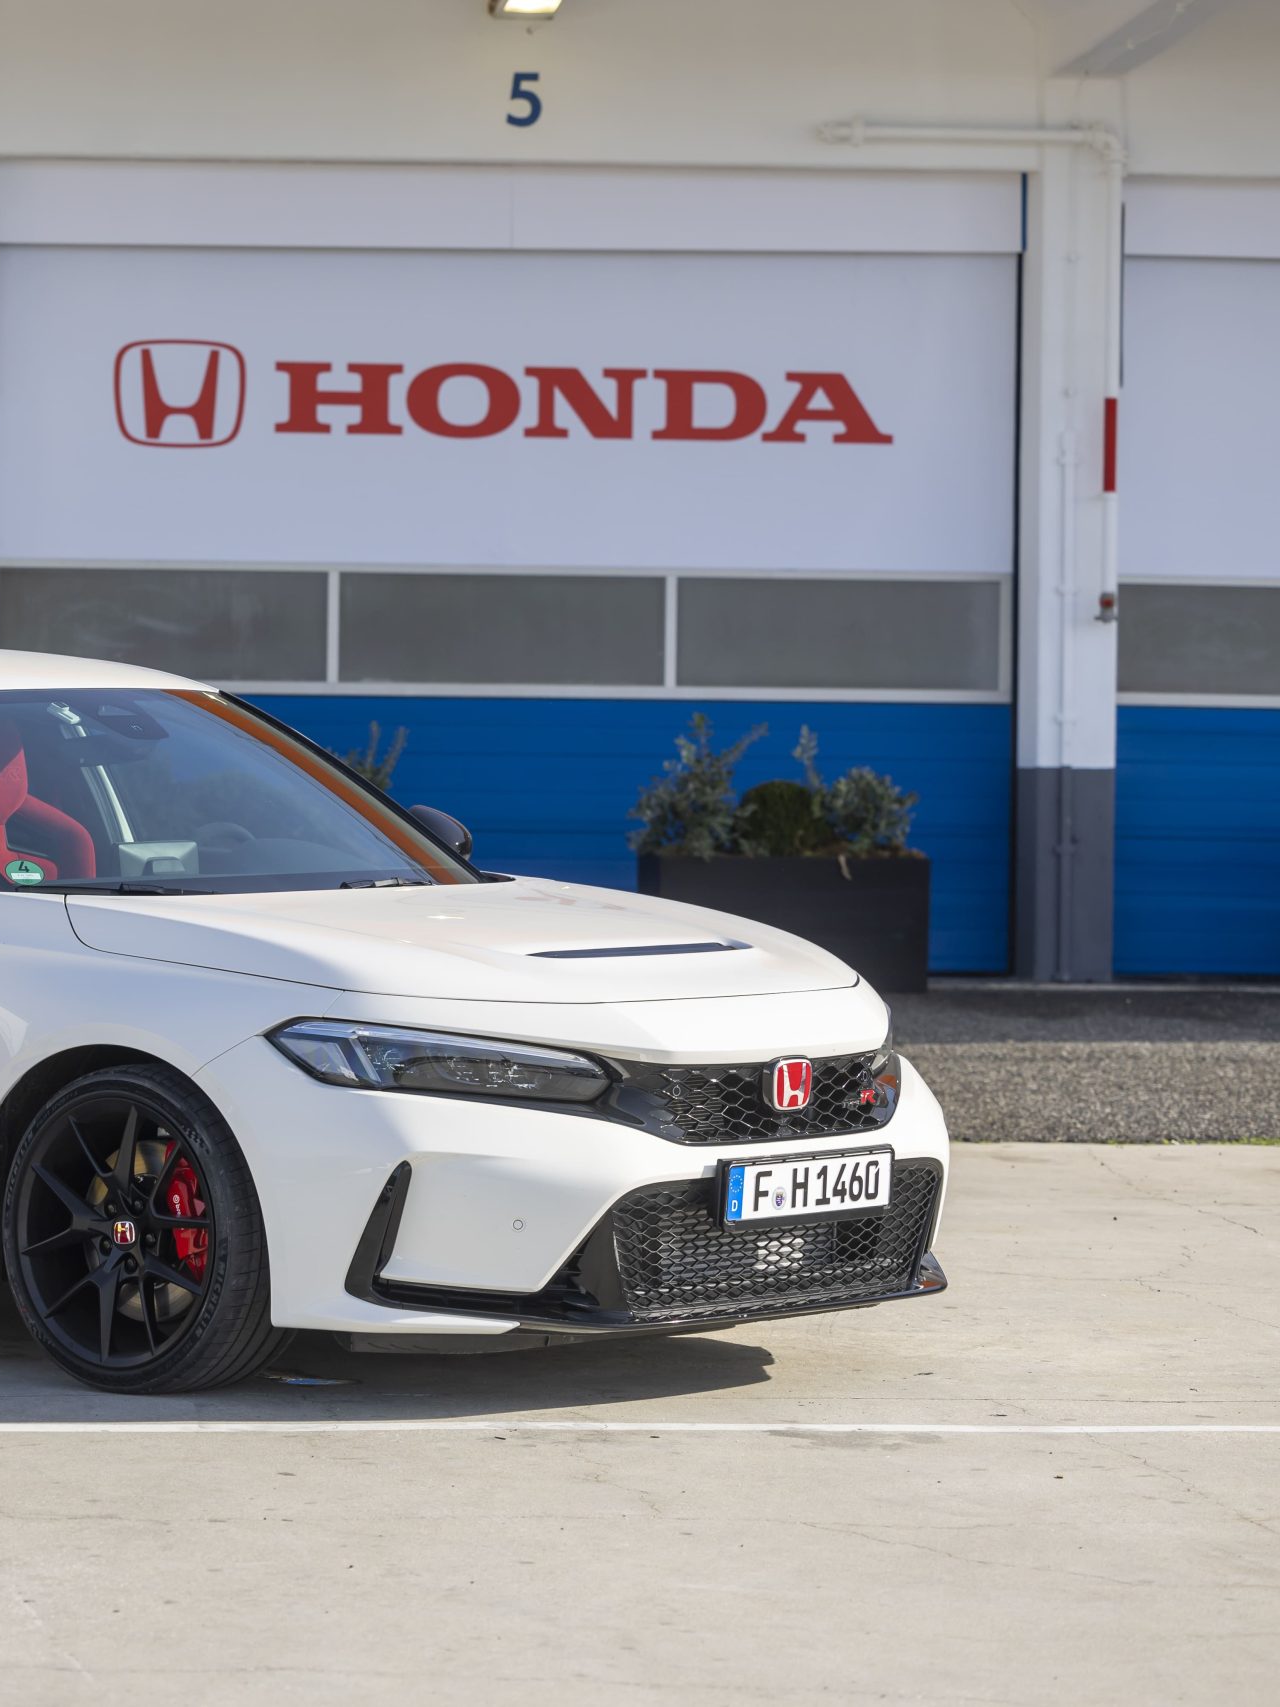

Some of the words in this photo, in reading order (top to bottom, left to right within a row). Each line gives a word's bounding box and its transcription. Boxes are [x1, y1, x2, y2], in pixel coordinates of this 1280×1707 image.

[507, 72, 542, 127] 5
[275, 361, 893, 444] HONDA
[18, 861, 30, 872] 4
[731, 1200, 738, 1212] D
[753, 1170, 772, 1211] F
